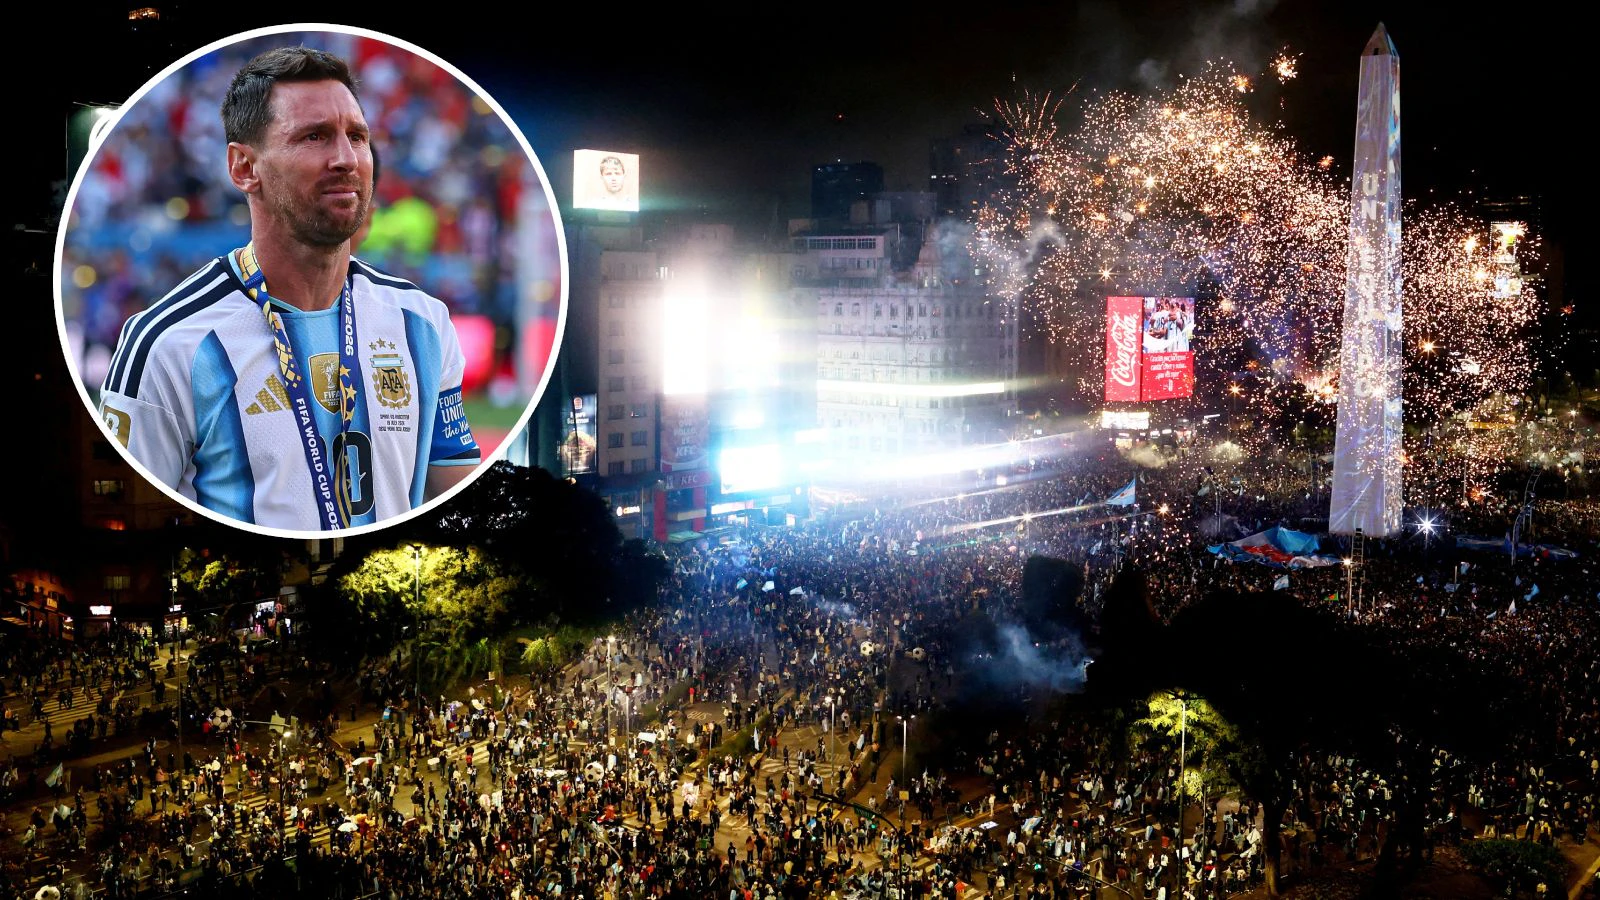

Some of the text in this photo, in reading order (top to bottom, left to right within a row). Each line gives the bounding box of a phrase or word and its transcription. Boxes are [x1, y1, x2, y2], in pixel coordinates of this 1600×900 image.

[1361, 172, 1379, 220] UN
[345, 314, 354, 357] 2026
[382, 368, 404, 393] AFA
[442, 424, 460, 439] the
[675, 445, 698, 457] KFC
[296, 397, 341, 531] FIFA WORLD CUP 202
[681, 474, 699, 486] KFC
